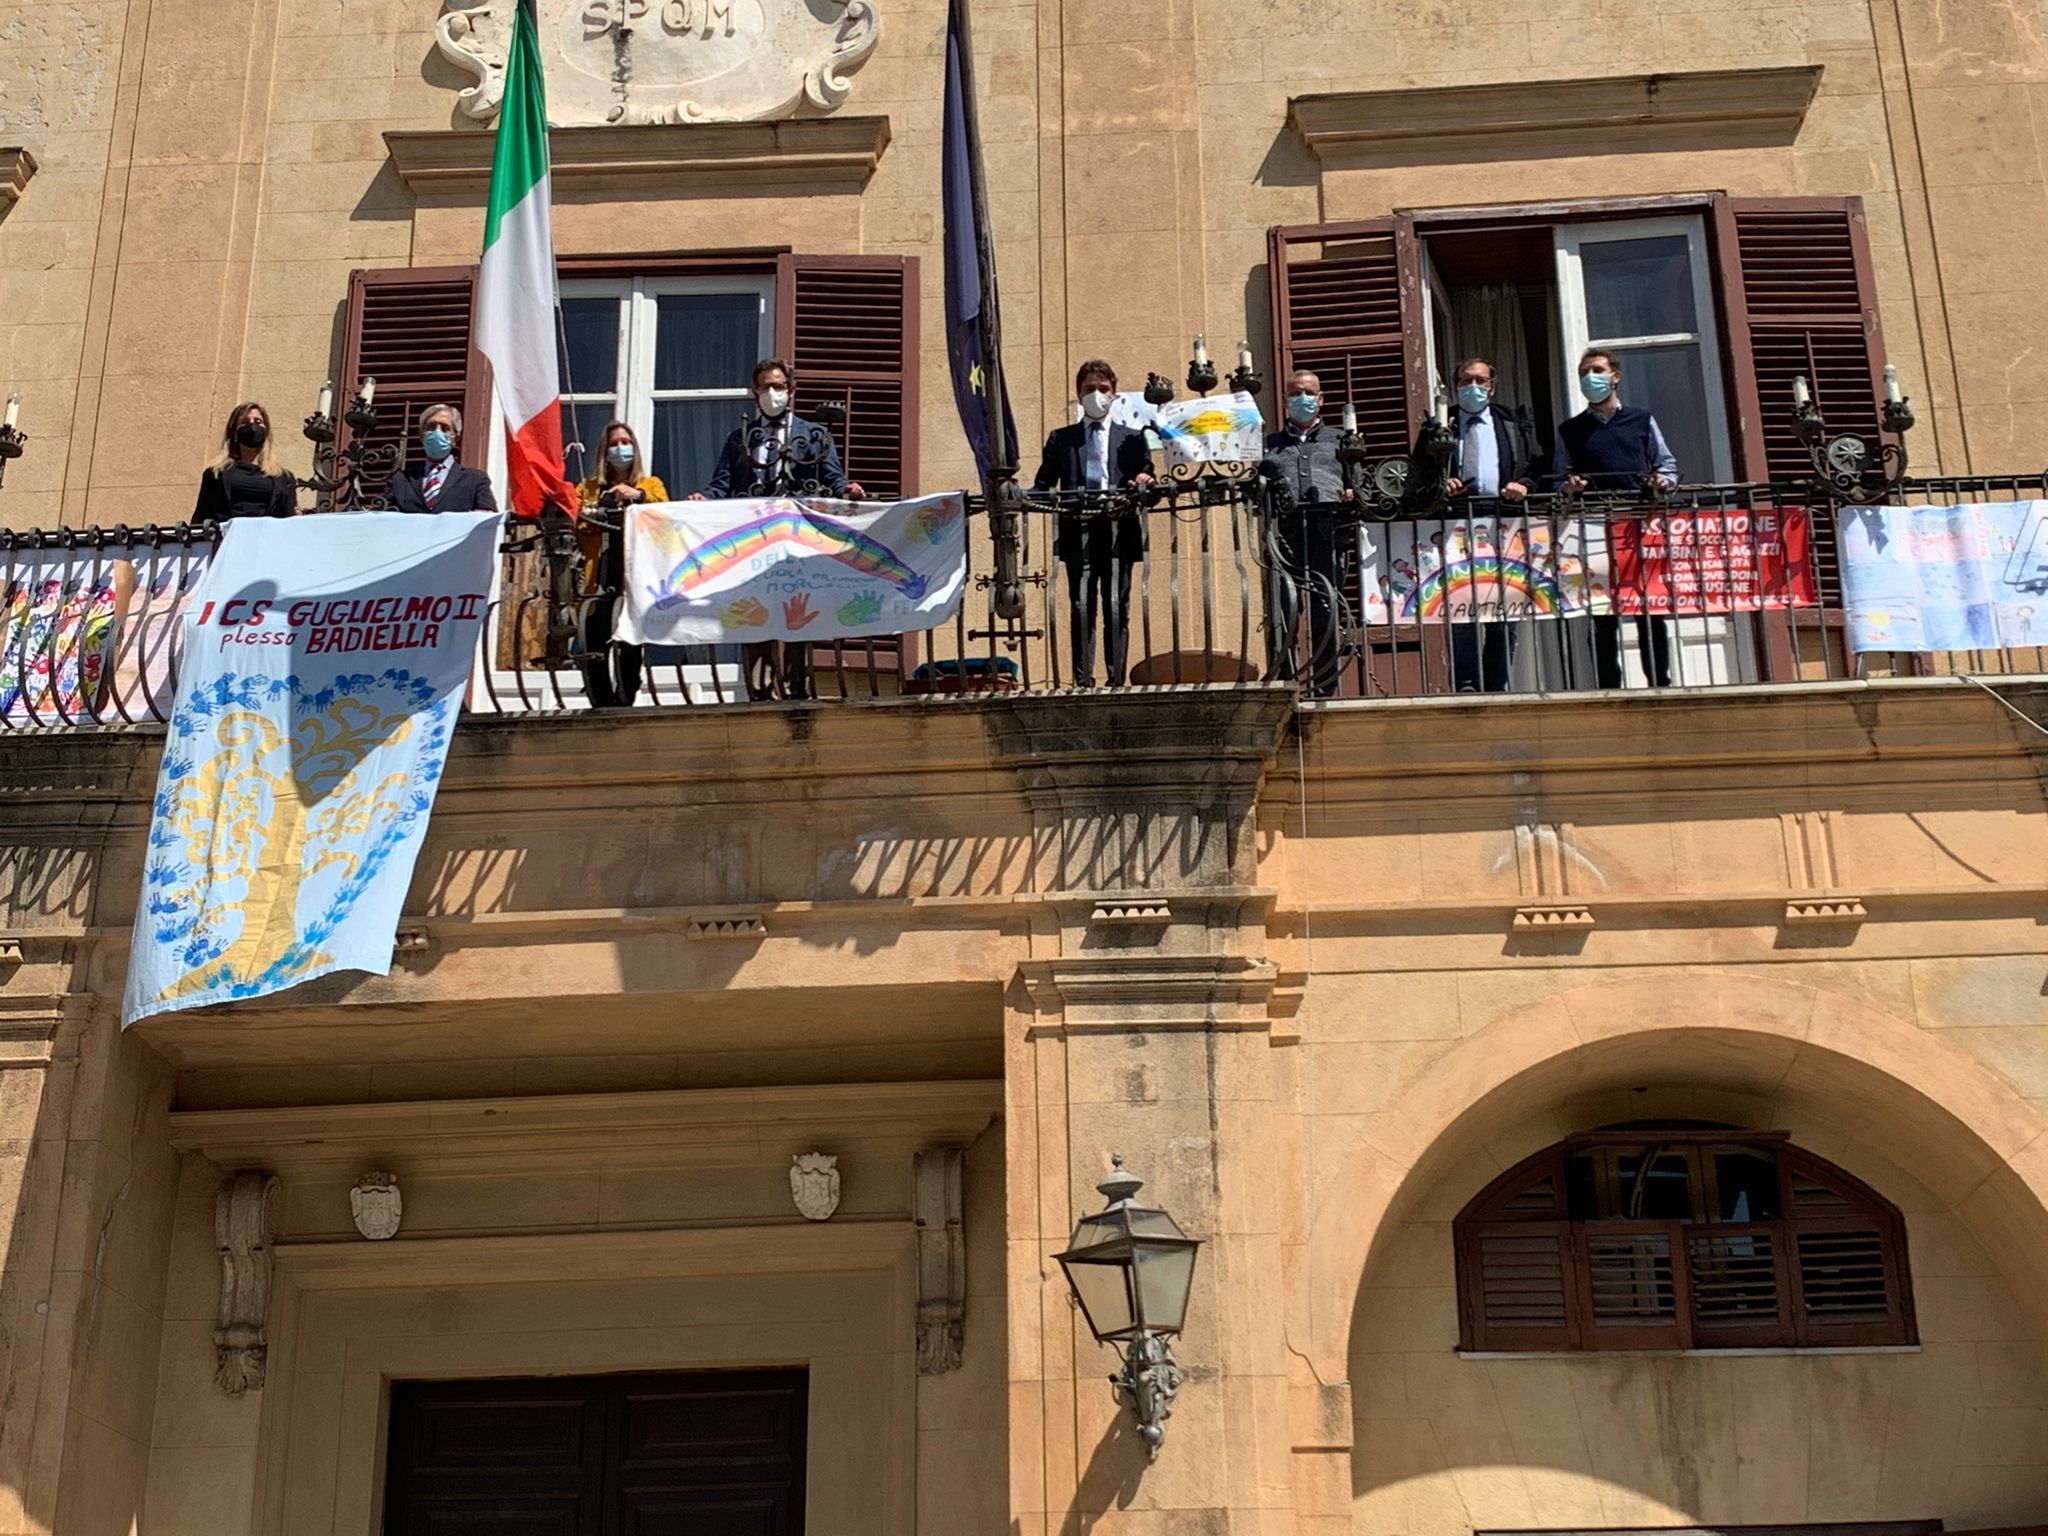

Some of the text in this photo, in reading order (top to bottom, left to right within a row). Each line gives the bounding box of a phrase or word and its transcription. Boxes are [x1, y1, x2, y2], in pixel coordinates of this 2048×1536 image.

[583, 0, 734, 37] SPQM
[1720, 542, 1780, 557] RAGZZI
[287, 595, 453, 626] GUGLIELMO
[453, 594, 486, 620] II
[220, 623, 439, 655] plesso BADIELLA
